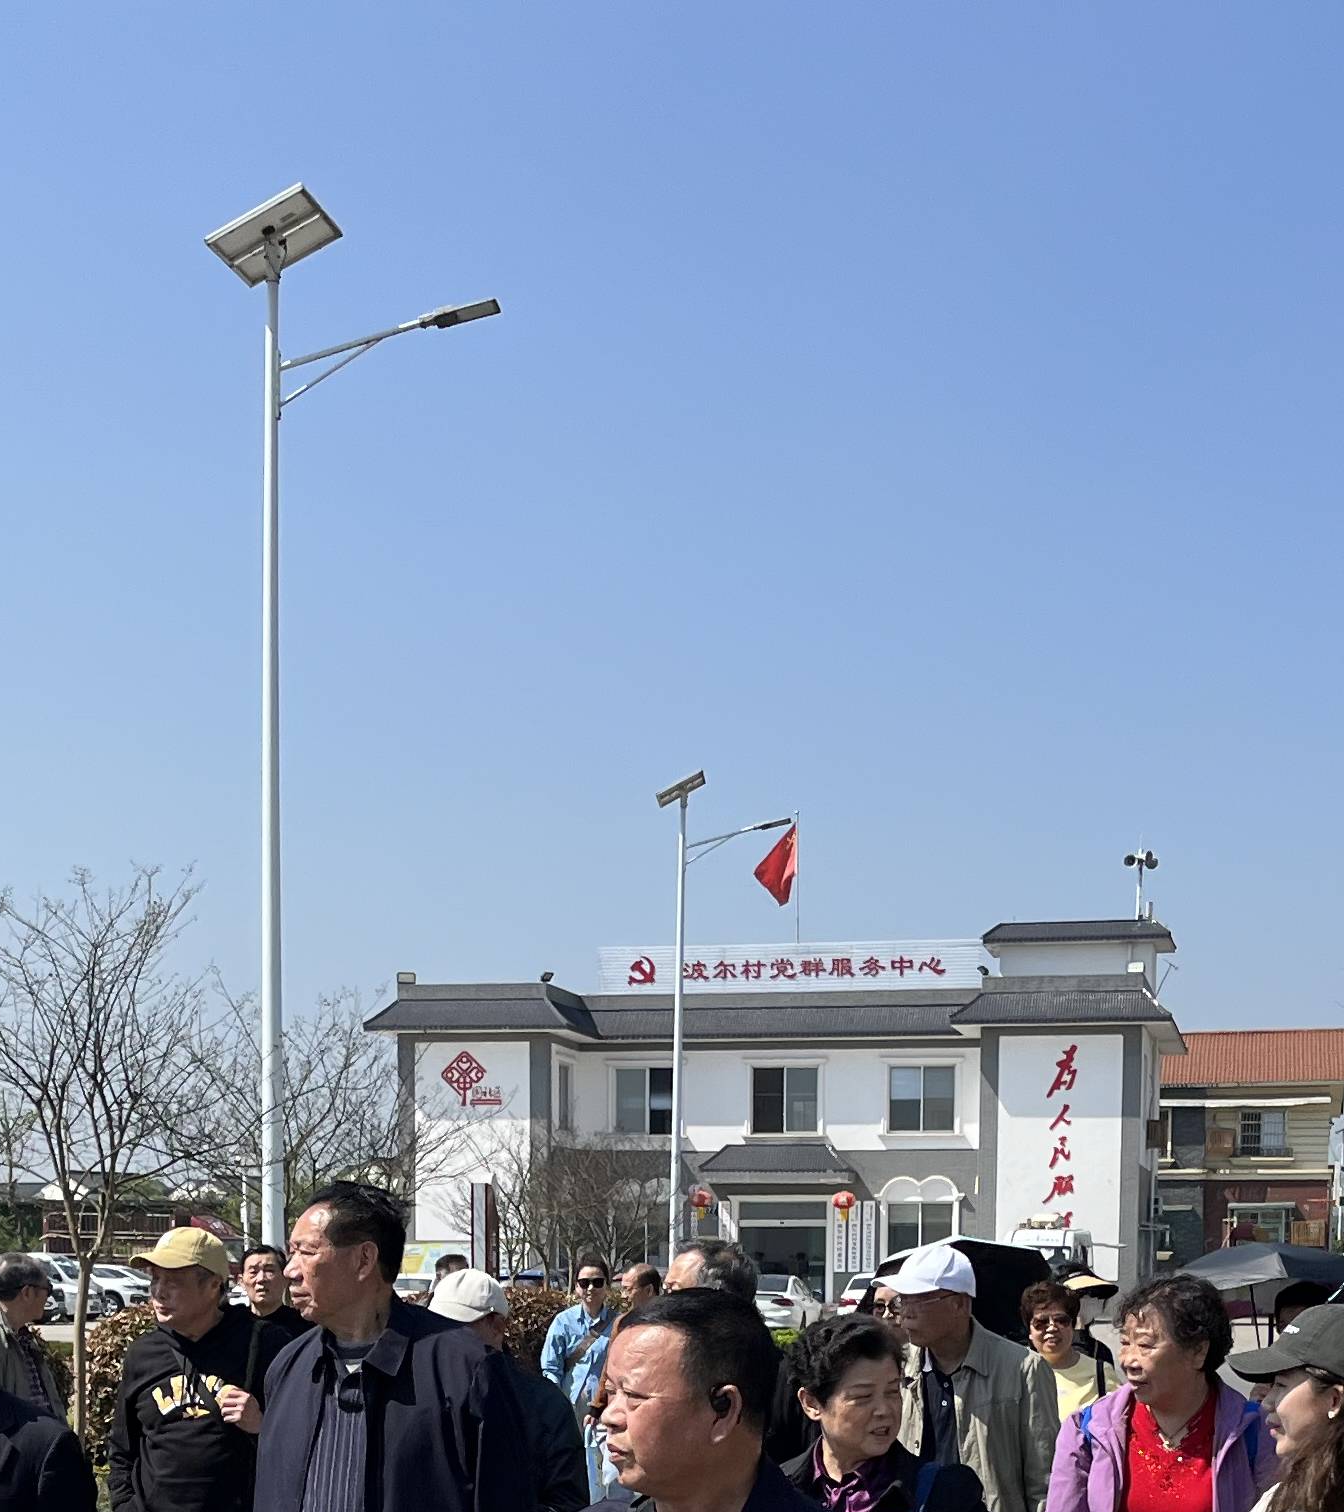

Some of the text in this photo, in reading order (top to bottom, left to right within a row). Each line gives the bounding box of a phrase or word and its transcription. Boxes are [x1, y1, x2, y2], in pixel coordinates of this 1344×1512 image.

[682, 955, 947, 982] 波尔村党群服务中心
